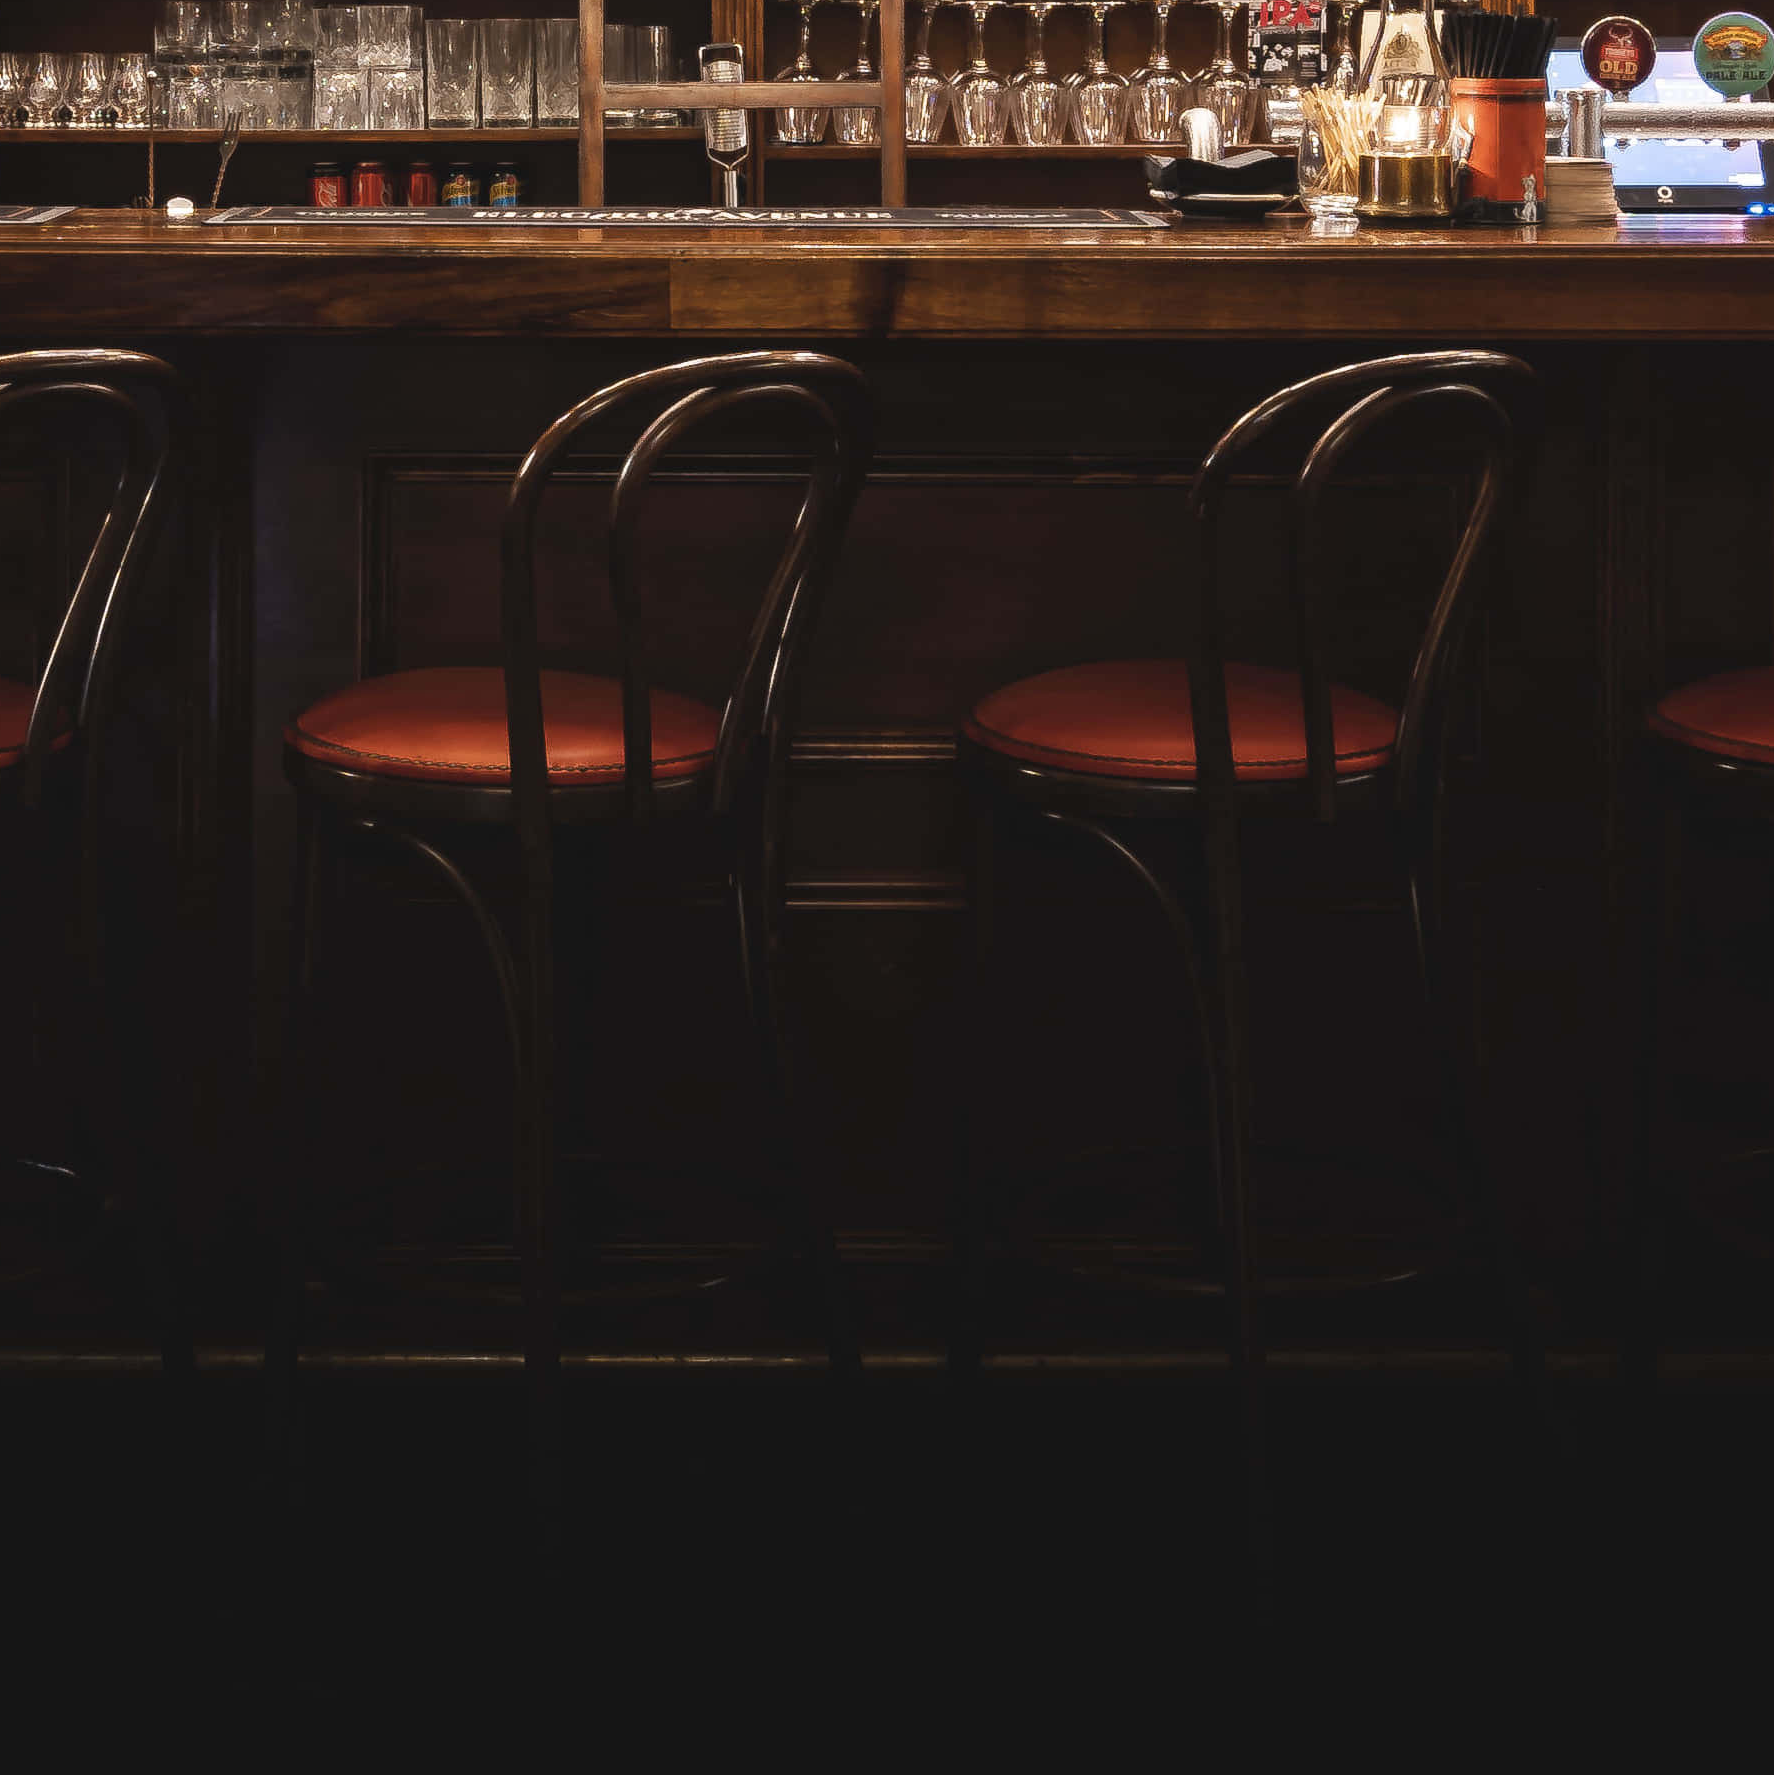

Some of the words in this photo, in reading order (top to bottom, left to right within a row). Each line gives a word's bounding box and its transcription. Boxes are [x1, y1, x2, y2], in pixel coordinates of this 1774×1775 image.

[1260, 0, 1315, 27] IPA
[1600, 60, 1638, 75] OLD
[1706, 70, 1737, 80] PALE
[1742, 70, 1766, 80] ALE
